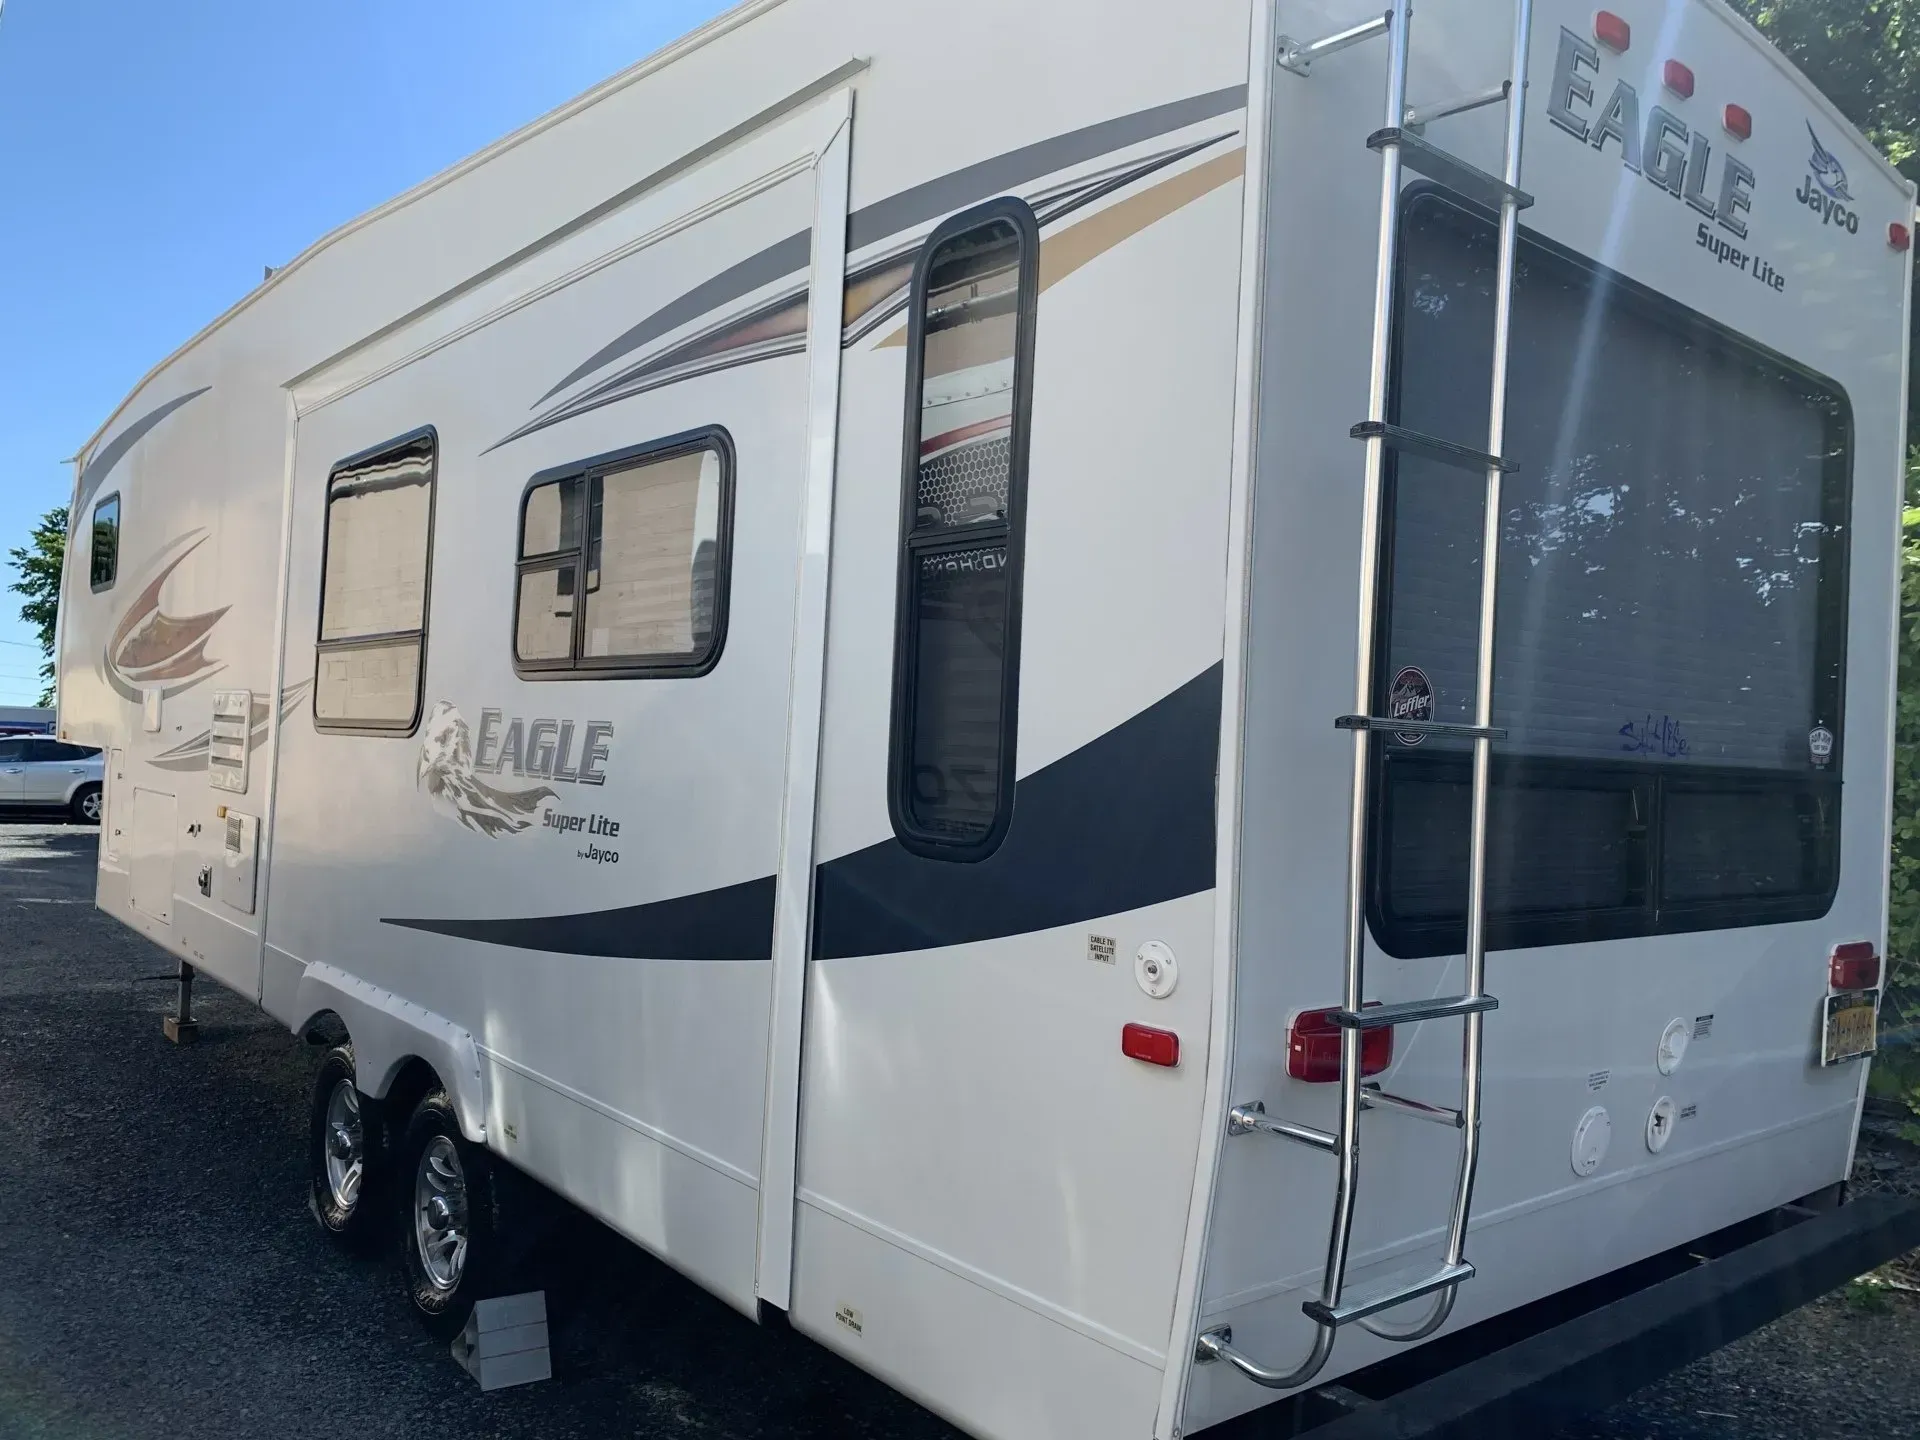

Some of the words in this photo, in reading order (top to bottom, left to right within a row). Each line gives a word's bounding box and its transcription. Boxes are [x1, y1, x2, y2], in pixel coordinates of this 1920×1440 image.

[1547, 25, 1755, 240] EAGLE
[1796, 174, 1859, 235] Jayco
[1696, 223, 1750, 275] Super
[1752, 255, 1785, 293] Lite
[1394, 695, 1429, 717] Leffler
[474, 707, 614, 786] EAGLE
[543, 808, 586, 835] Super
[588, 813, 620, 838] Lite
[577, 850, 584, 859] by
[584, 843, 619, 865] Jayco
[1090, 935, 1106, 946] CABLE
[1090, 944, 1115, 955] SATELLITE
[1094, 953, 1110, 963] INPUT
[836, 1312, 848, 1324] POINT
[848, 1319, 862, 1332] DRAIN
[843, 1307, 854, 1318] LOW
